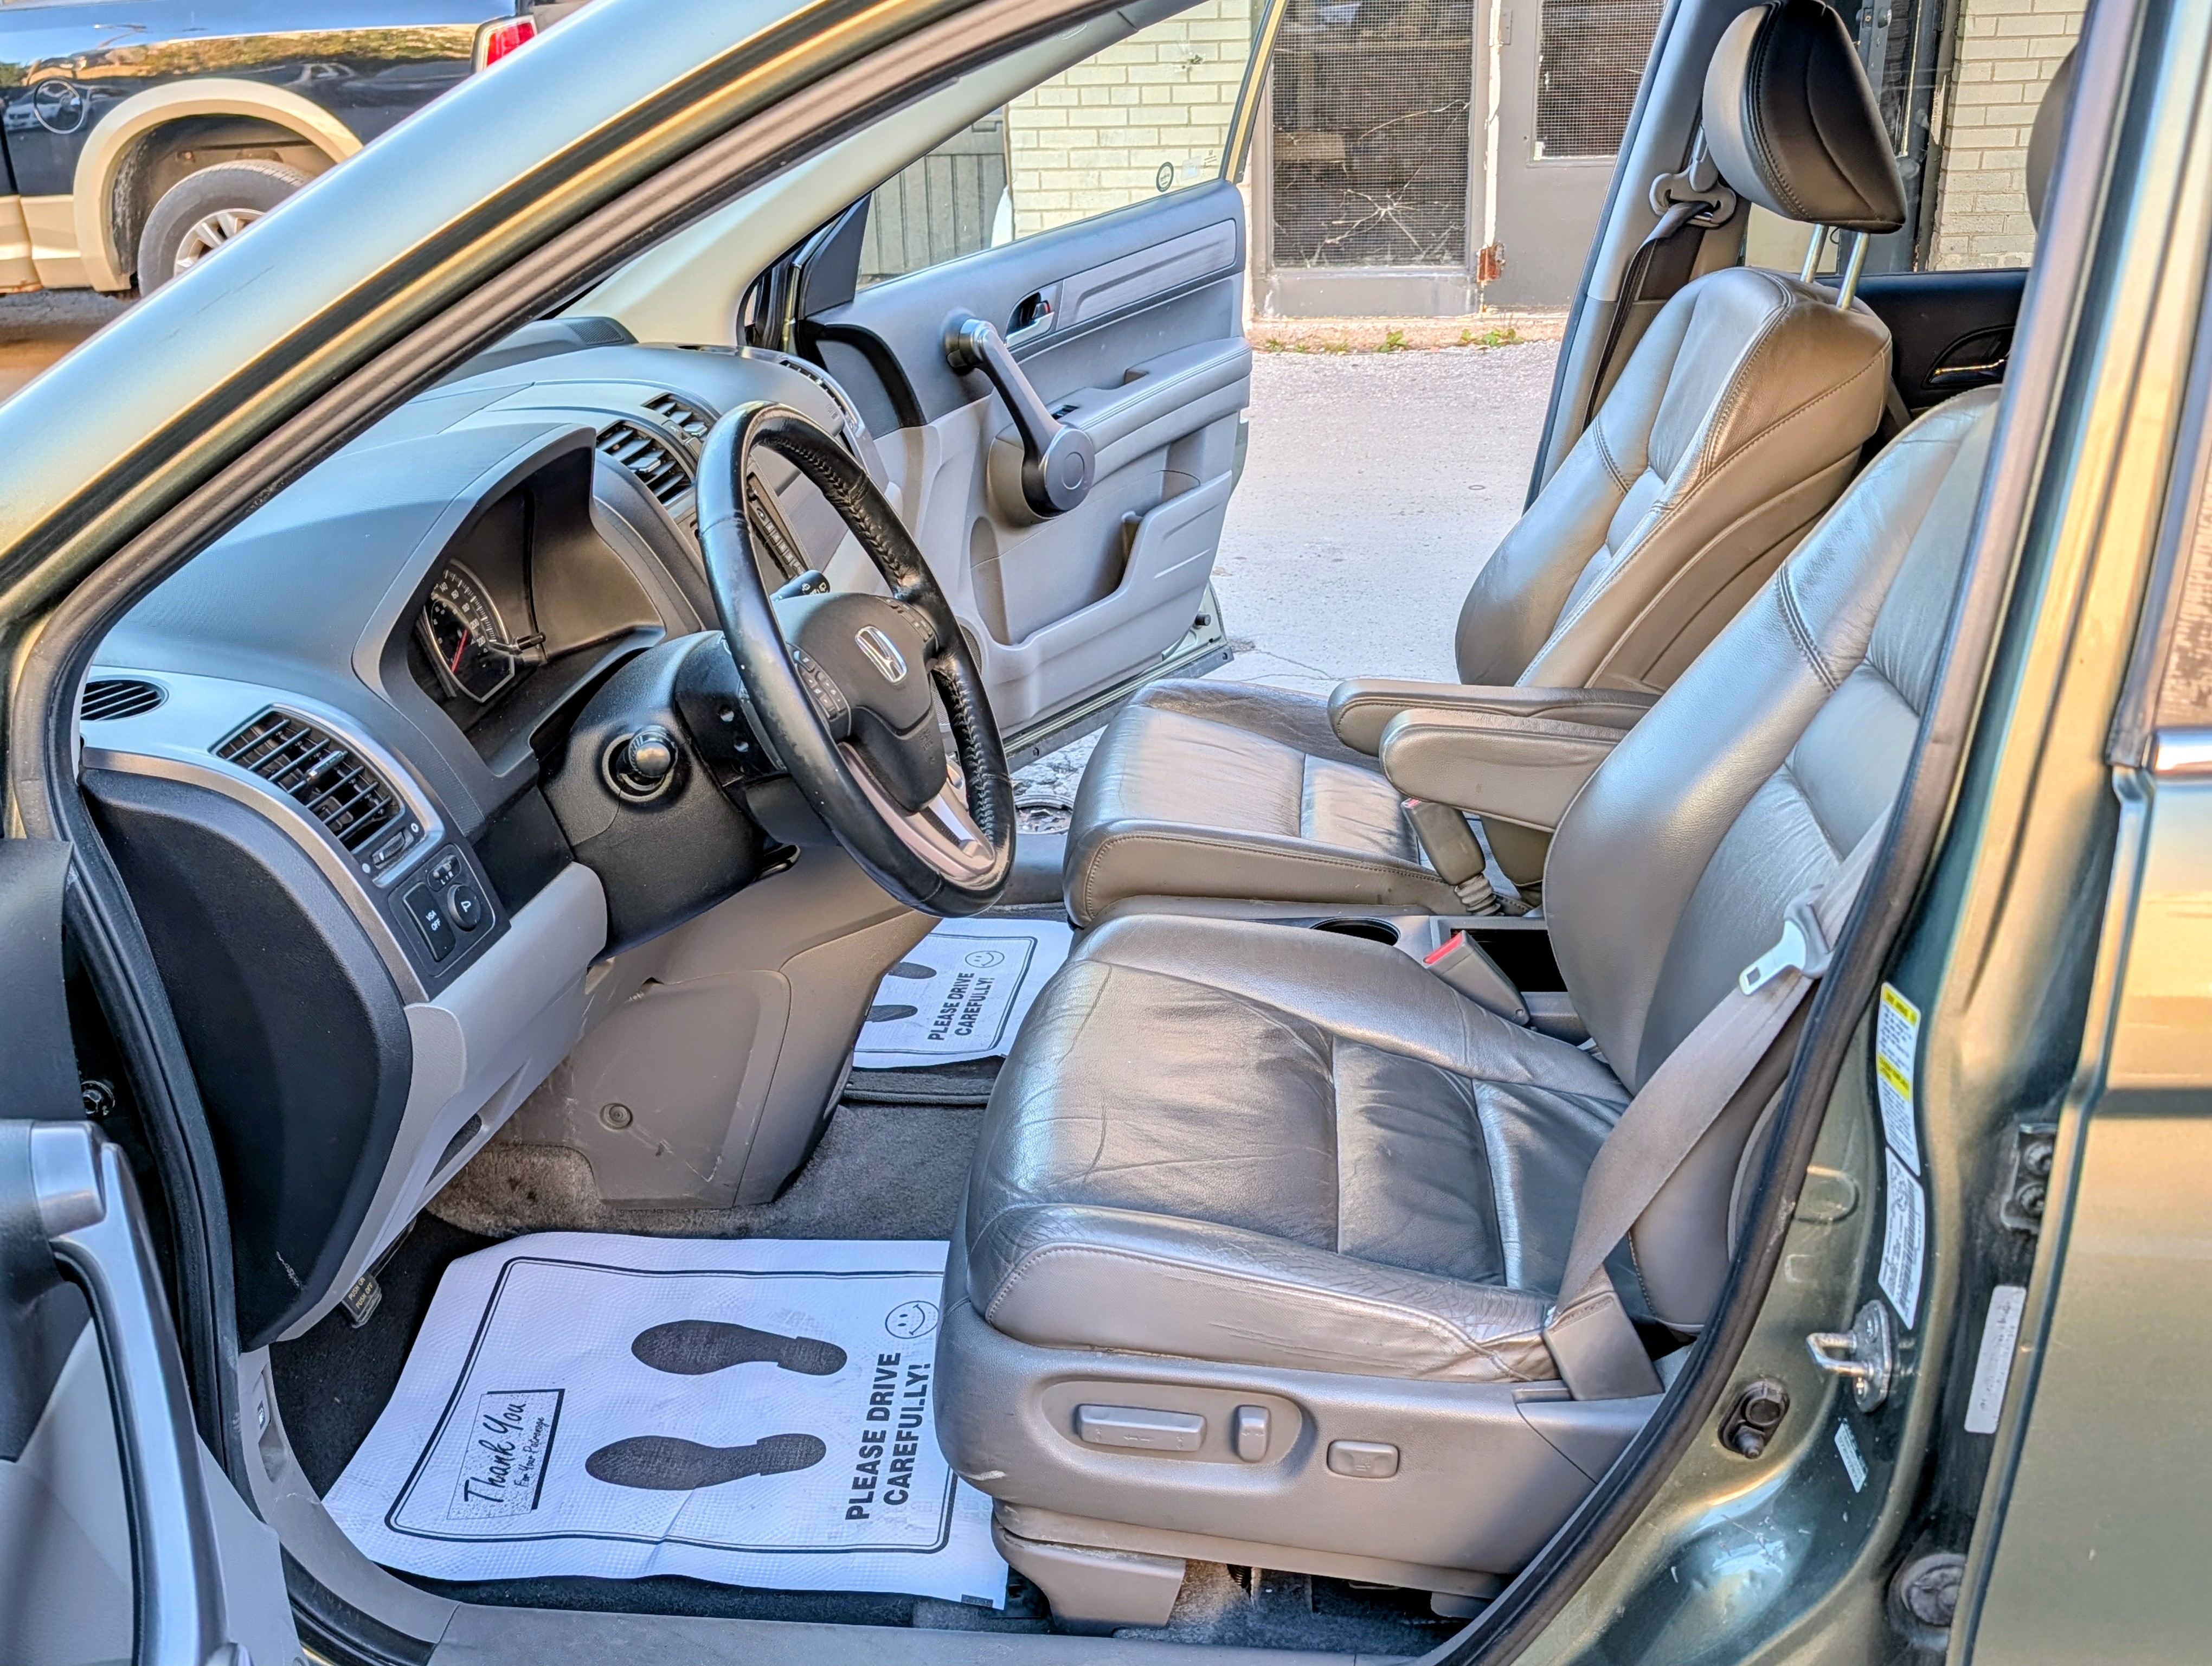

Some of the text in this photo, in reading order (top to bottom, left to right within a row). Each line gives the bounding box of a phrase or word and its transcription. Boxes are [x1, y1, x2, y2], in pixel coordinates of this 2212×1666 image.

[470, 618, 479, 630] 200
[477, 636, 486, 647] 220
[426, 910, 437, 921] VSA
[431, 918, 440, 931] OFF
[927, 972, 975, 1041] PLEASE DRIVE
[954, 978, 995, 1036] CAREFULLY!
[348, 1277, 365, 1300] PUSH ON
[355, 1282, 373, 1309] PUSH OFF
[464, 1403, 526, 1502] Thank You
[513, 1473, 531, 1487] For
[523, 1417, 550, 1454] Patronage
[845, 1353, 901, 1520] PLEASE DRIVE
[883, 1363, 931, 1505] CAREFULLY!
